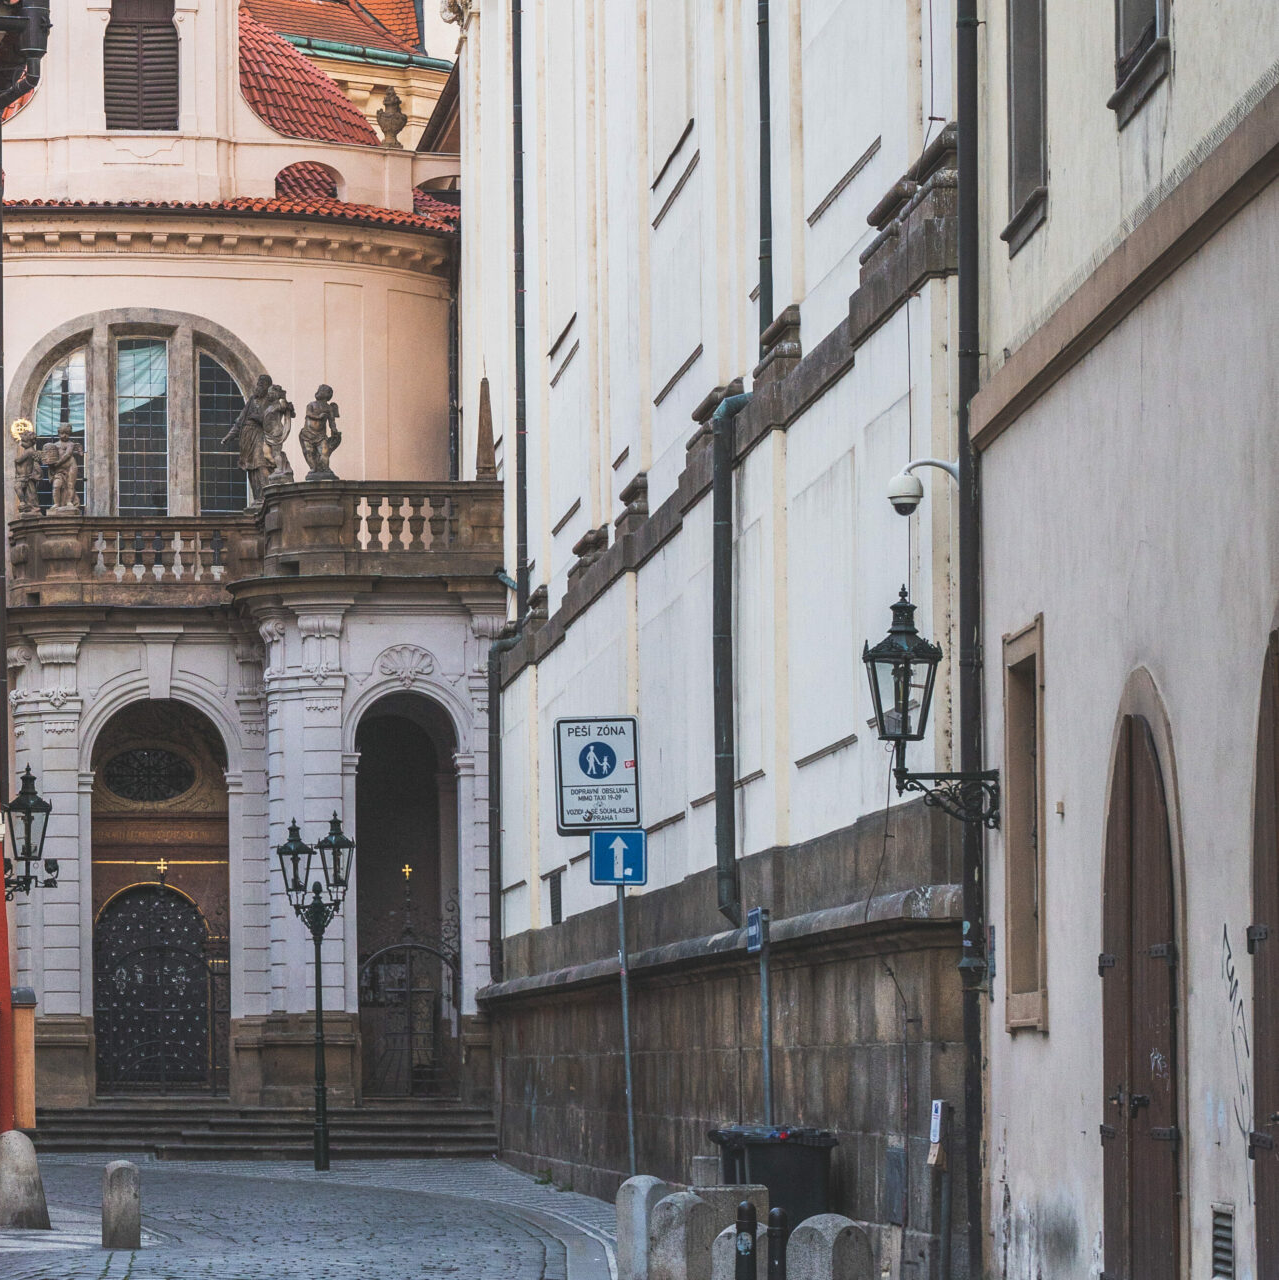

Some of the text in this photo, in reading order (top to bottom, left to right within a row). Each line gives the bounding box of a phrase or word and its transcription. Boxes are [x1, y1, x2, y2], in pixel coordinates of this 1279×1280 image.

[567, 725, 626, 737] PĚŠÍ ZÓNA
[599, 807, 635, 815] SOUHLASEM
